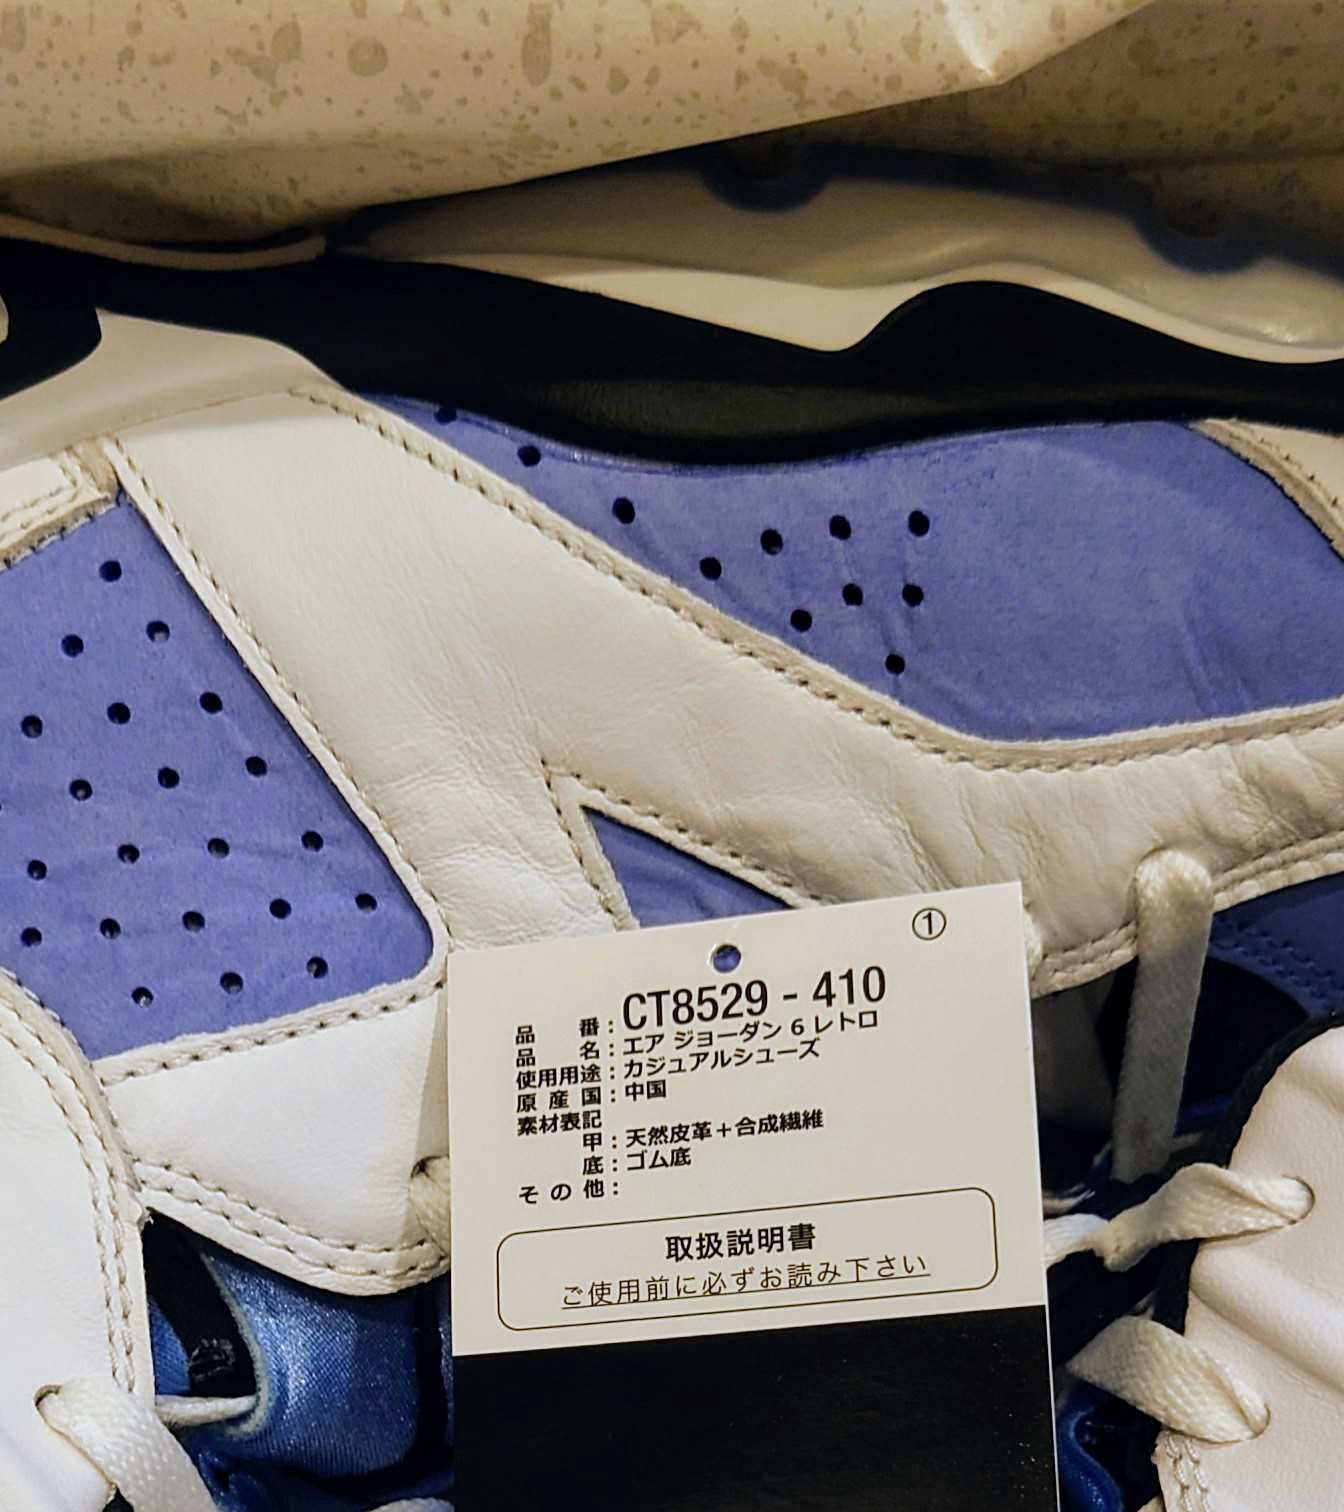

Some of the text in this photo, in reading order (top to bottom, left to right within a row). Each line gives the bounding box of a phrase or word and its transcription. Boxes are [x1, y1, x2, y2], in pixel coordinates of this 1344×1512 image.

[623, 979, 769, 1030] CT8529
[812, 965, 886, 1008] 410
[624, 1079, 667, 1102] 中国
[517, 1109, 602, 1136] 素材表記
[626, 1147, 692, 1172] ゴム底
[665, 1223, 816, 1263] 取扱説明書
[561, 1253, 928, 1308] ご使用前に必ずお読み下さい
